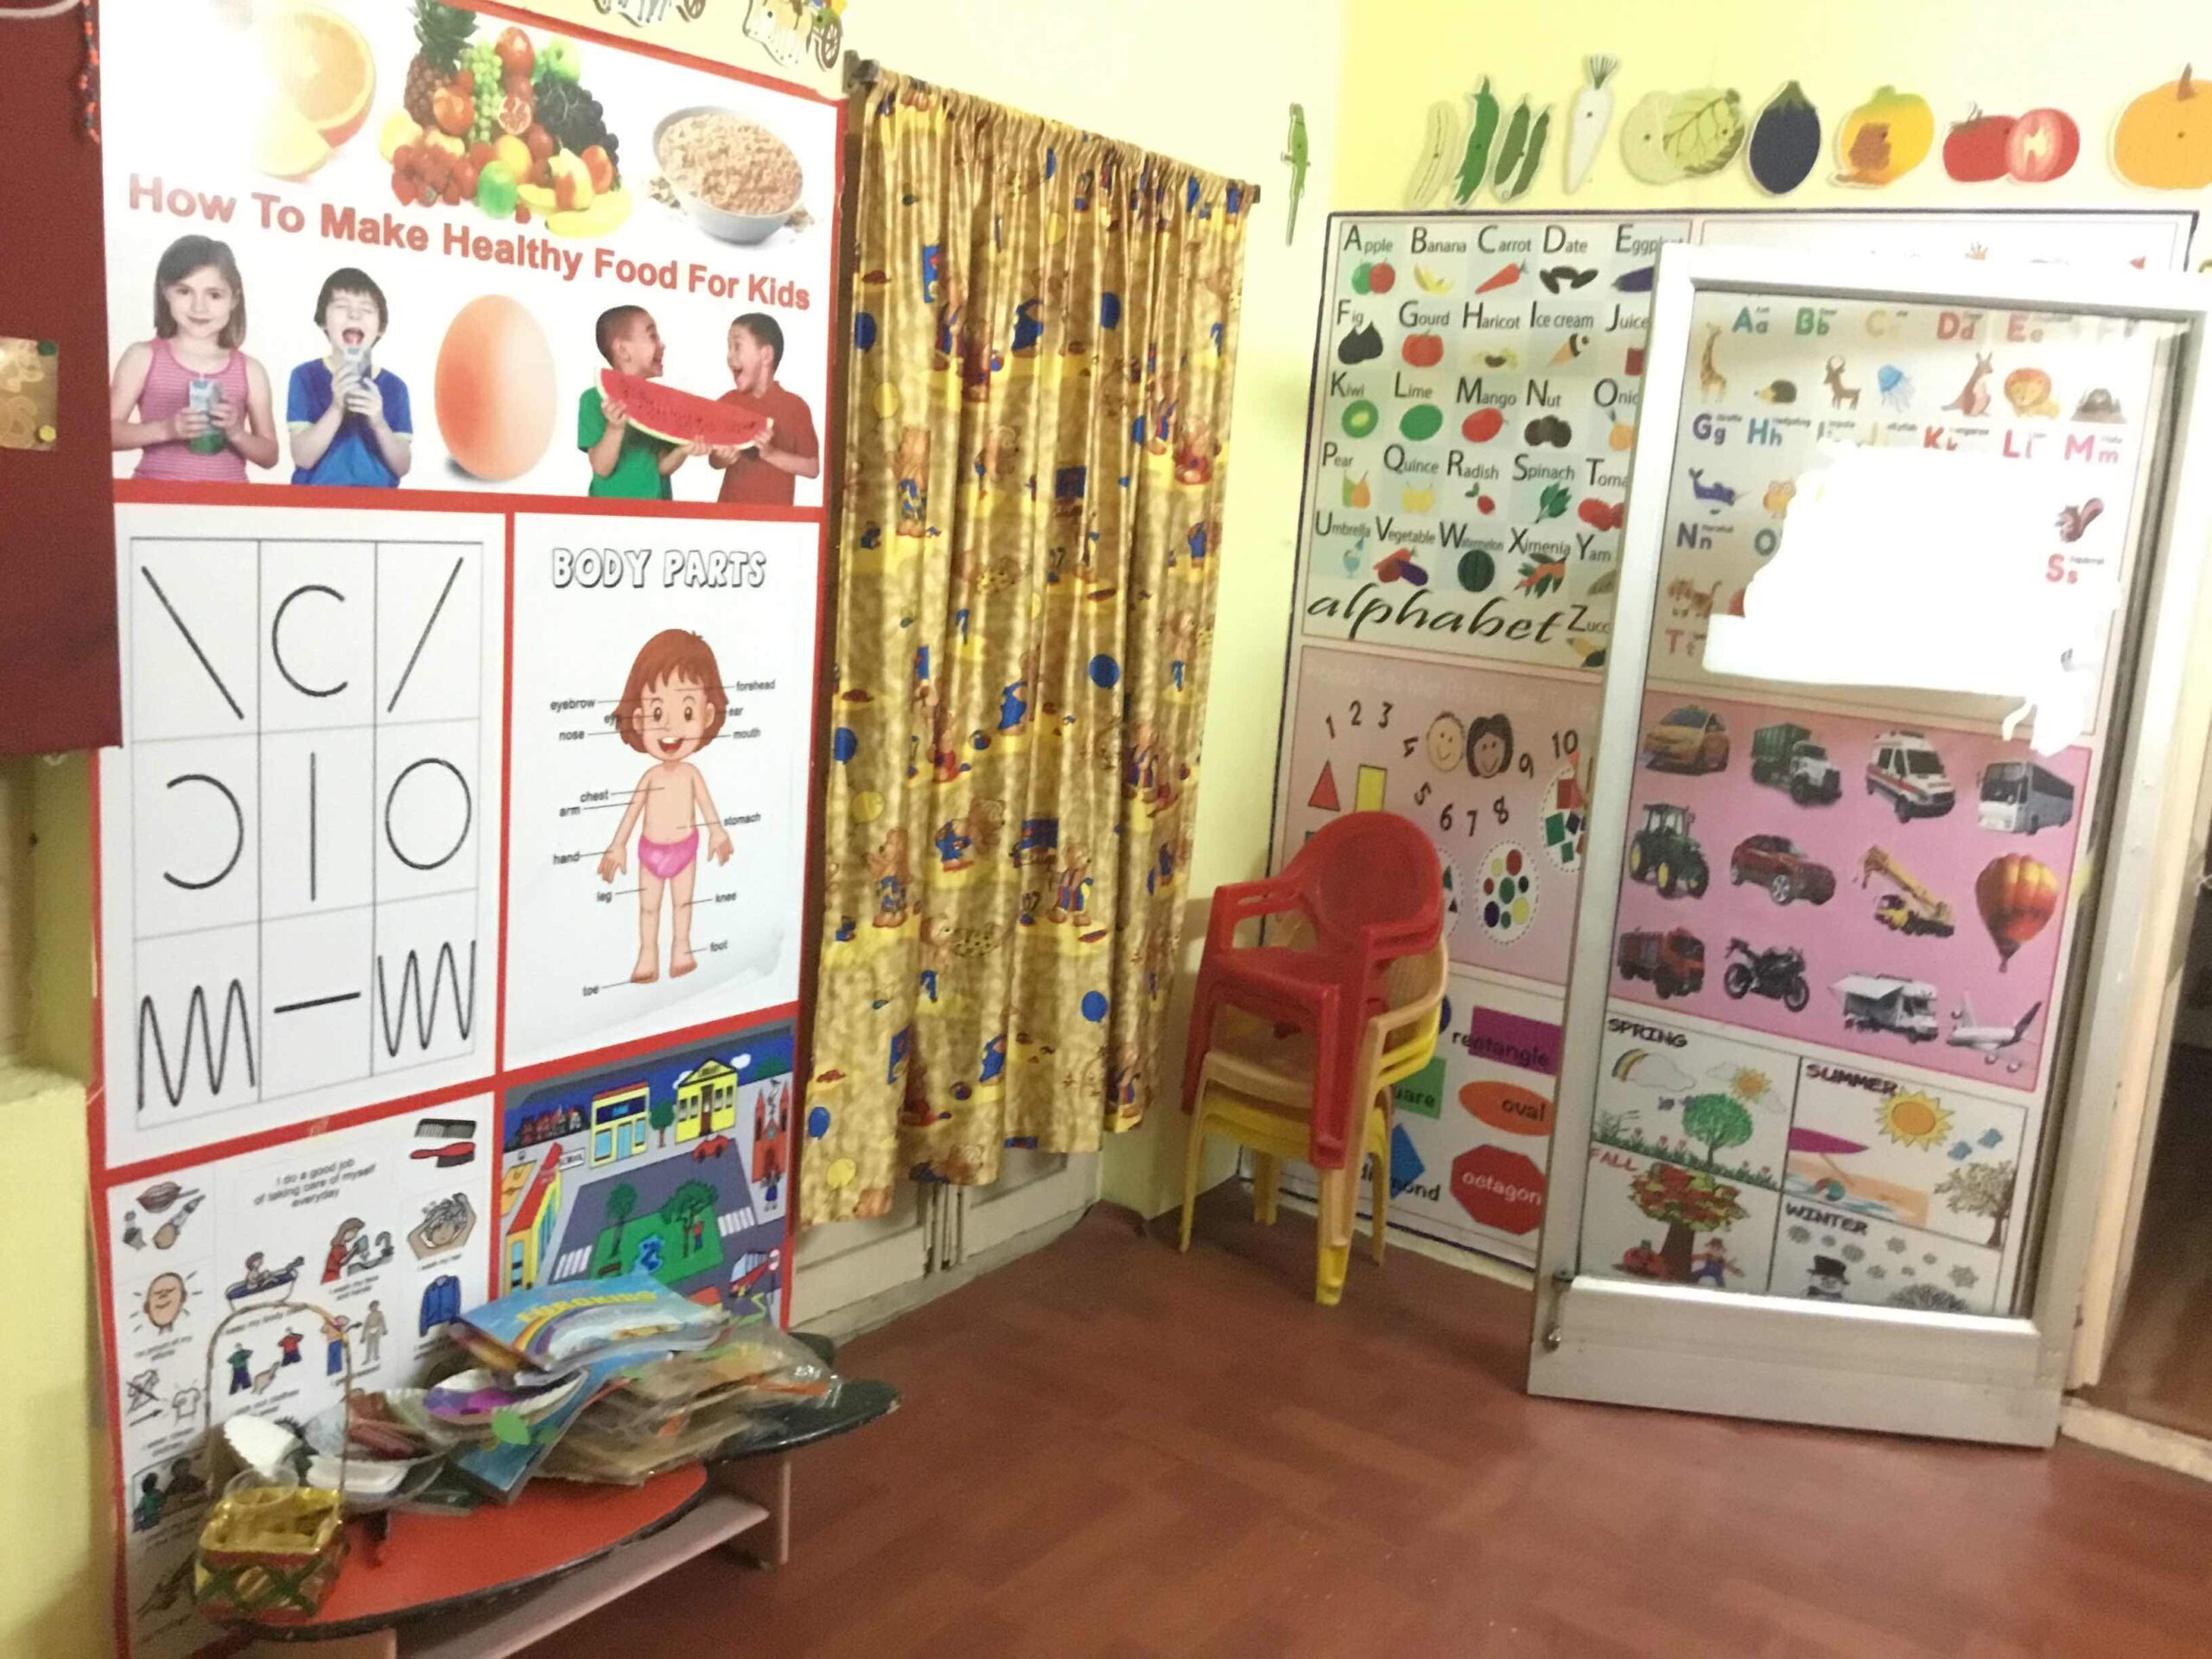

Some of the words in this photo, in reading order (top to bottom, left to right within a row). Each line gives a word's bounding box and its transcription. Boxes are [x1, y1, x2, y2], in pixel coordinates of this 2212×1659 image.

[127, 174, 236, 225] How
[251, 193, 305, 234] To
[320, 204, 429, 252] Make
[442, 225, 583, 282] Healthy
[594, 251, 678, 290] Food
[689, 265, 740, 296] For
[748, 273, 810, 311] Kids
[1343, 225, 1394, 255] Apple
[1410, 226, 1467, 254] Banana
[1478, 226, 1532, 254] Carrot
[1542, 226, 1588, 254] Date
[1337, 300, 1363, 327] Fig
[1399, 302, 1450, 327] Gourd
[1463, 302, 1521, 330] Haricot
[1530, 302, 1551, 328] Ice
[1554, 315, 1594, 329] cream
[1605, 303, 1649, 333] Juice
[1330, 372, 1365, 398] Kiwi
[1395, 372, 1433, 399] Lime
[1456, 378, 1517, 407] Mango
[1526, 379, 1561, 407] Nut
[1594, 378, 1640, 407] Onio
[1322, 442, 1353, 468] Pear
[1382, 444, 1440, 474] Quince
[1447, 450, 1499, 480] Radish
[1512, 454, 1575, 482] Spinach
[1586, 458, 1629, 487] Toma
[1315, 511, 1370, 538] Umbrella
[1376, 515, 1436, 544] Vegetable
[1508, 527, 1572, 555] Ximenia
[1577, 533, 1612, 562] Yam
[552, 547, 652, 588] BODY
[663, 549, 767, 588] PARTS
[1306, 582, 1567, 644] alphabet
[1567, 604, 1611, 633] Zucc
[735, 679, 777, 692] forehead
[550, 697, 596, 712] eyebrow
[1349, 699, 1363, 727] 2
[1377, 701, 1394, 729] 3
[558, 730, 586, 741] nose
[733, 728, 761, 739] mouth
[1325, 715, 1336, 740] 1
[1551, 728, 1580, 760] 10
[1518, 753, 1535, 780] 9
[559, 804, 582, 817] arm
[580, 790, 609, 804] chest
[1493, 796, 1510, 824] 8
[723, 812, 762, 826] stomach
[1440, 804, 1453, 832] 6
[1466, 809, 1478, 837] 7
[553, 852, 582, 865] hand
[596, 891, 613, 903] leg
[715, 892, 737, 903] knee
[709, 939, 728, 952] foot
[582, 985, 600, 997] toe
[1607, 1017, 1688, 1049] SPRING
[1451, 1028, 1550, 1070] rectangle
[1806, 1063, 1899, 1096] SUMMER
[1394, 1086, 1435, 1109] uare
[1501, 1097, 1546, 1122] oval
[309, 1161, 337, 1180] good
[1590, 1147, 1638, 1173] FALL
[1461, 1171, 1542, 1206] octagon
[1785, 1201, 1870, 1236] WINTER
